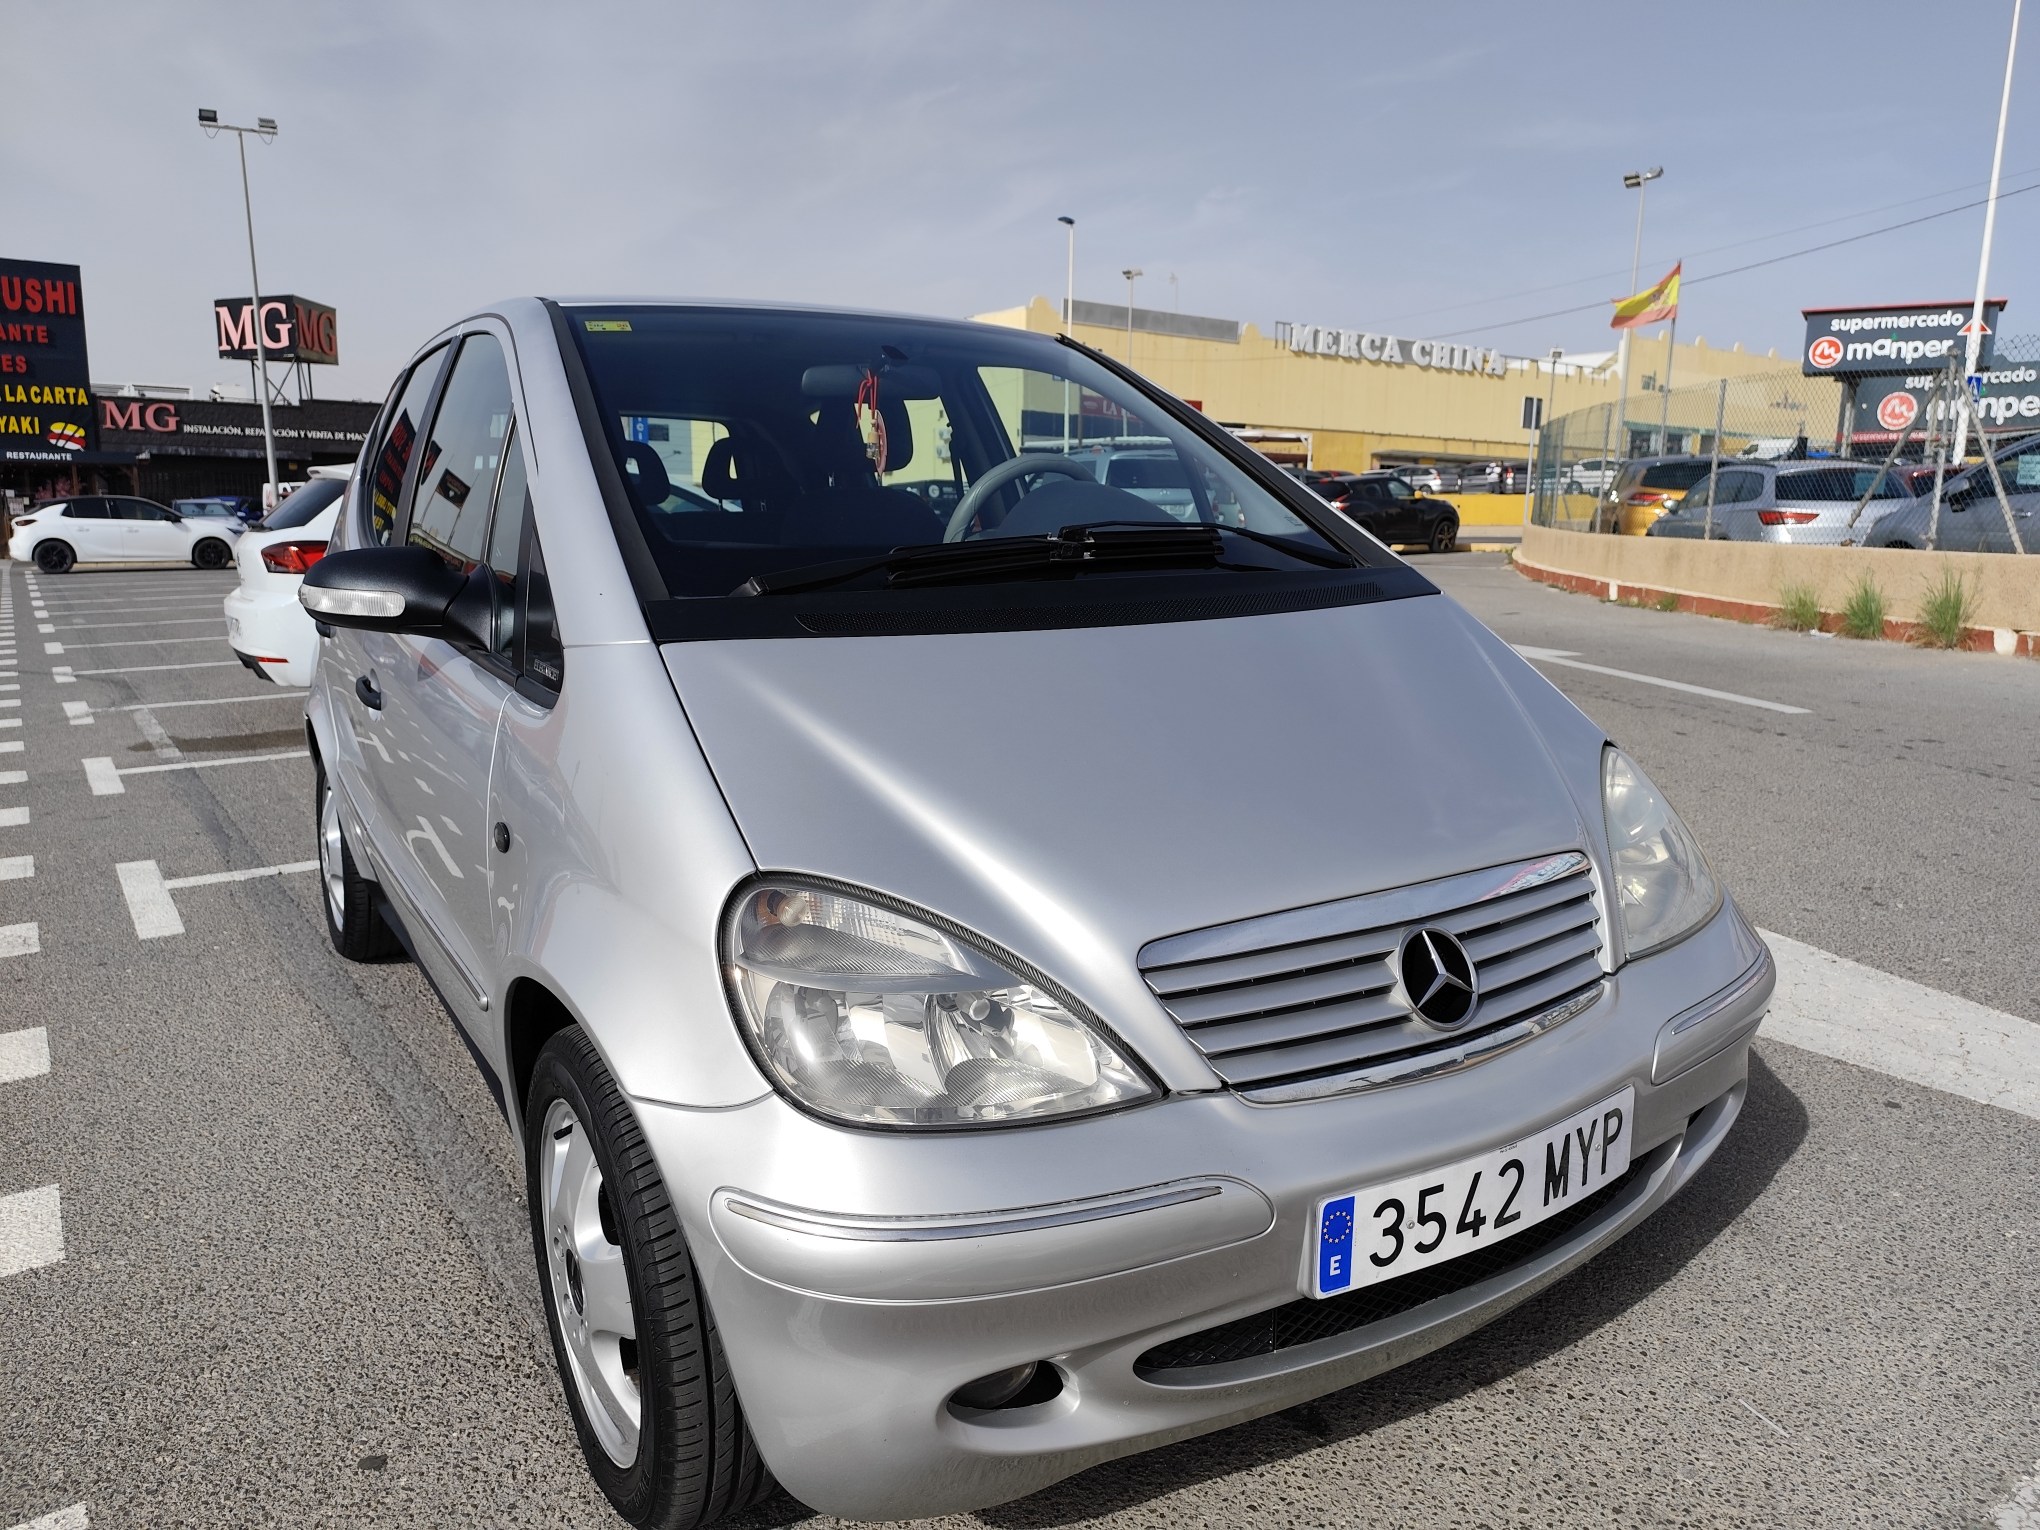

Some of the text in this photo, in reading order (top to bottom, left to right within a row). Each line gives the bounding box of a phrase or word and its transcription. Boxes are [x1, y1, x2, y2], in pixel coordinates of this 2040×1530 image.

[215, 301, 292, 351] MG
[295, 303, 337, 355] MG
[1830, 310, 1964, 334] supermercado
[1290, 322, 1506, 376] MERCA CHINA
[1846, 338, 1954, 365] manper
[30, 386, 89, 406] CARTA
[0, 416, 40, 435] YAKI
[100, 399, 181, 434] MG
[245, 427, 299, 438] REPAACIÓN
[306, 431, 333, 440] VENTA
[334, 432, 345, 440] DE
[6, 450, 73, 461] RESTAURANTE
[1329, 1107, 1624, 1276] E 3542 MYP
